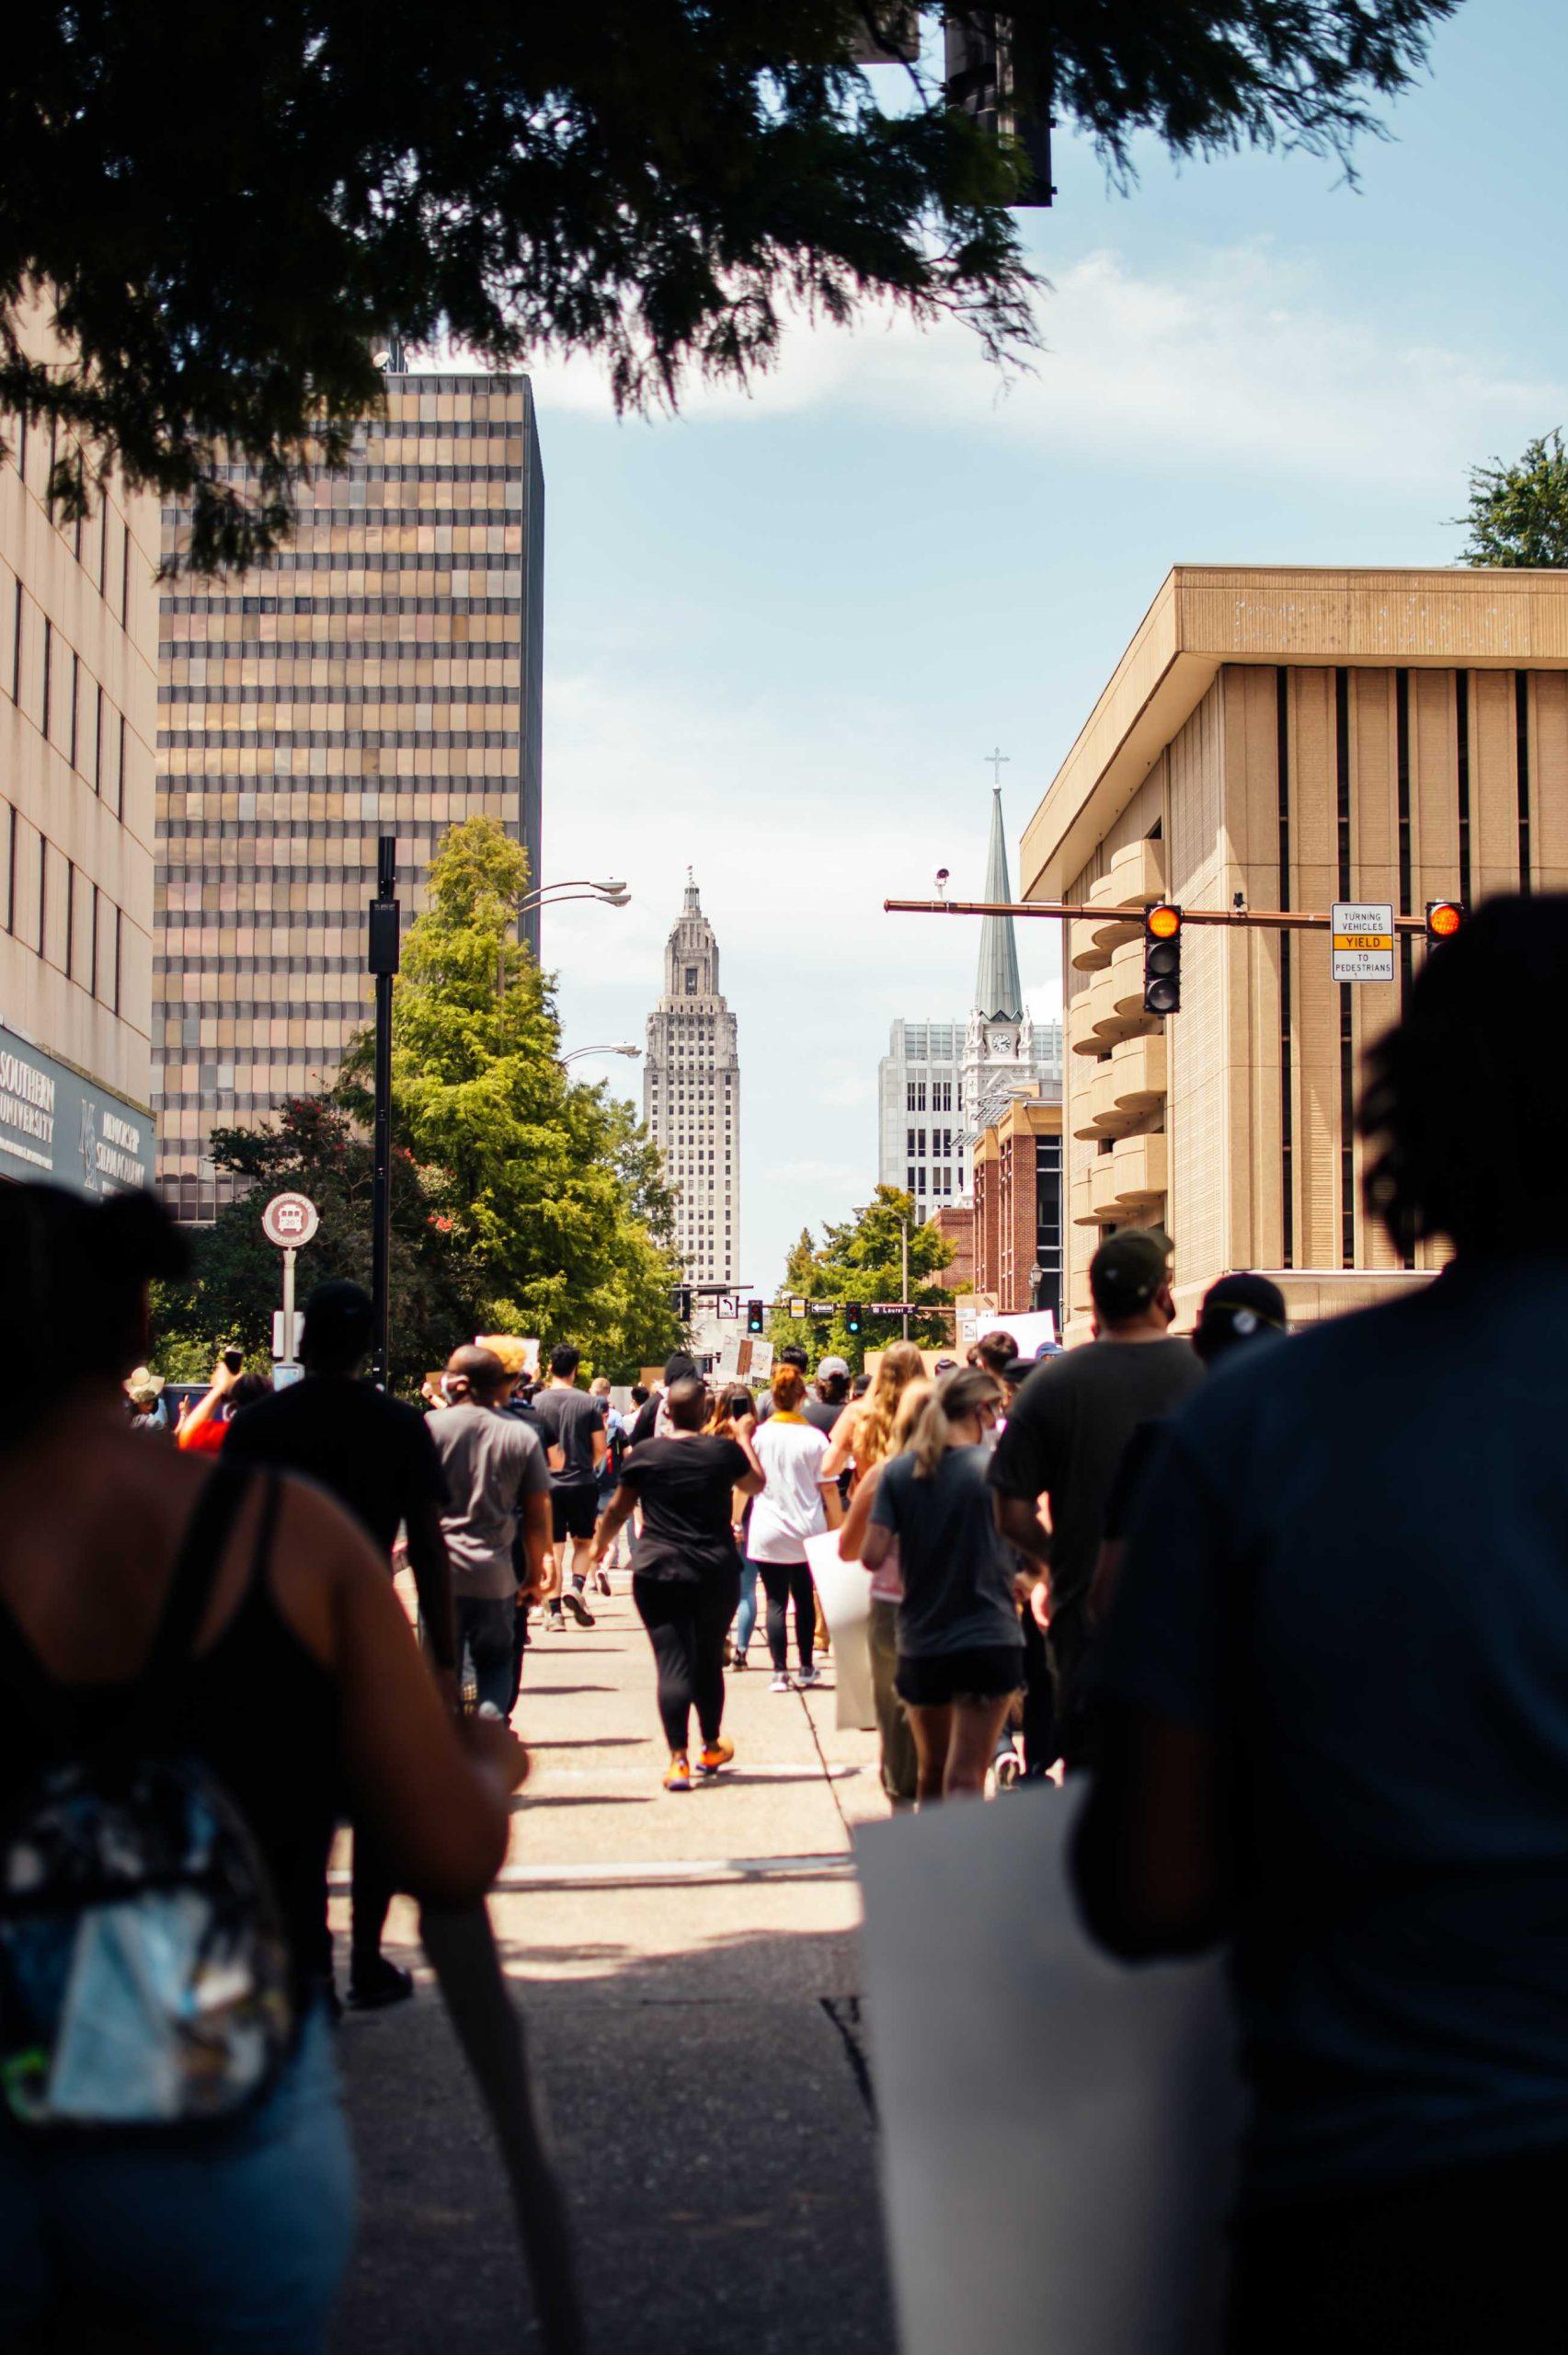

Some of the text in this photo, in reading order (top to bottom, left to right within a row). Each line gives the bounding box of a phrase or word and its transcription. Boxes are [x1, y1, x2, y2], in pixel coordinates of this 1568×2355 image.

[1345, 913, 1381, 921] TURNING
[1343, 923, 1383, 931] VEHICLES
[1346, 937, 1380, 948] YIELD
[1357, 954, 1368, 962] TO
[1335, 963, 1391, 972] PEDESTRIANS
[0, 1051, 55, 1115] SOUTHERN
[0, 1092, 54, 1143] UNIVERSITY
